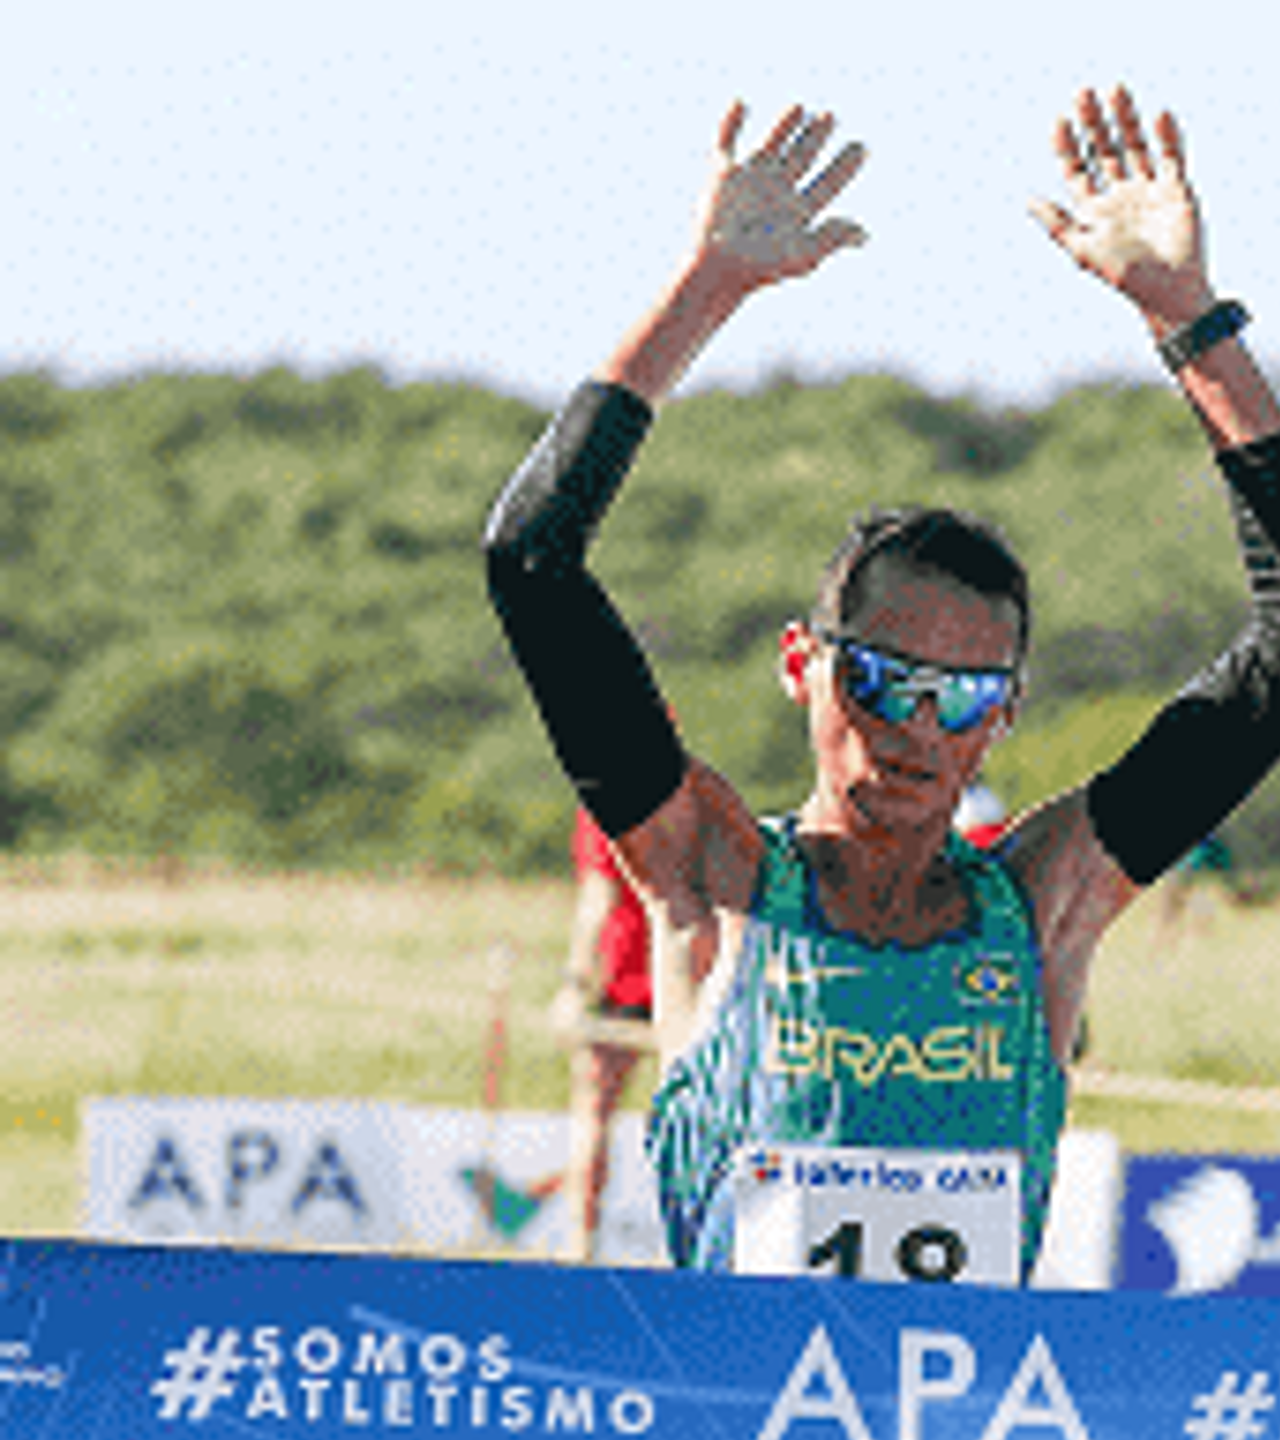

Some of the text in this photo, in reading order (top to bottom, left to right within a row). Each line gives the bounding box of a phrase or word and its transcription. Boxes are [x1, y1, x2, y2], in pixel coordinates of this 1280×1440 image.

[770, 1020, 1014, 1087] BRASIL
[127, 1130, 368, 1218] APA
[150, 1325, 514, 1422] #SOMOS
[245, 1376, 655, 1434] ATLETISMO
